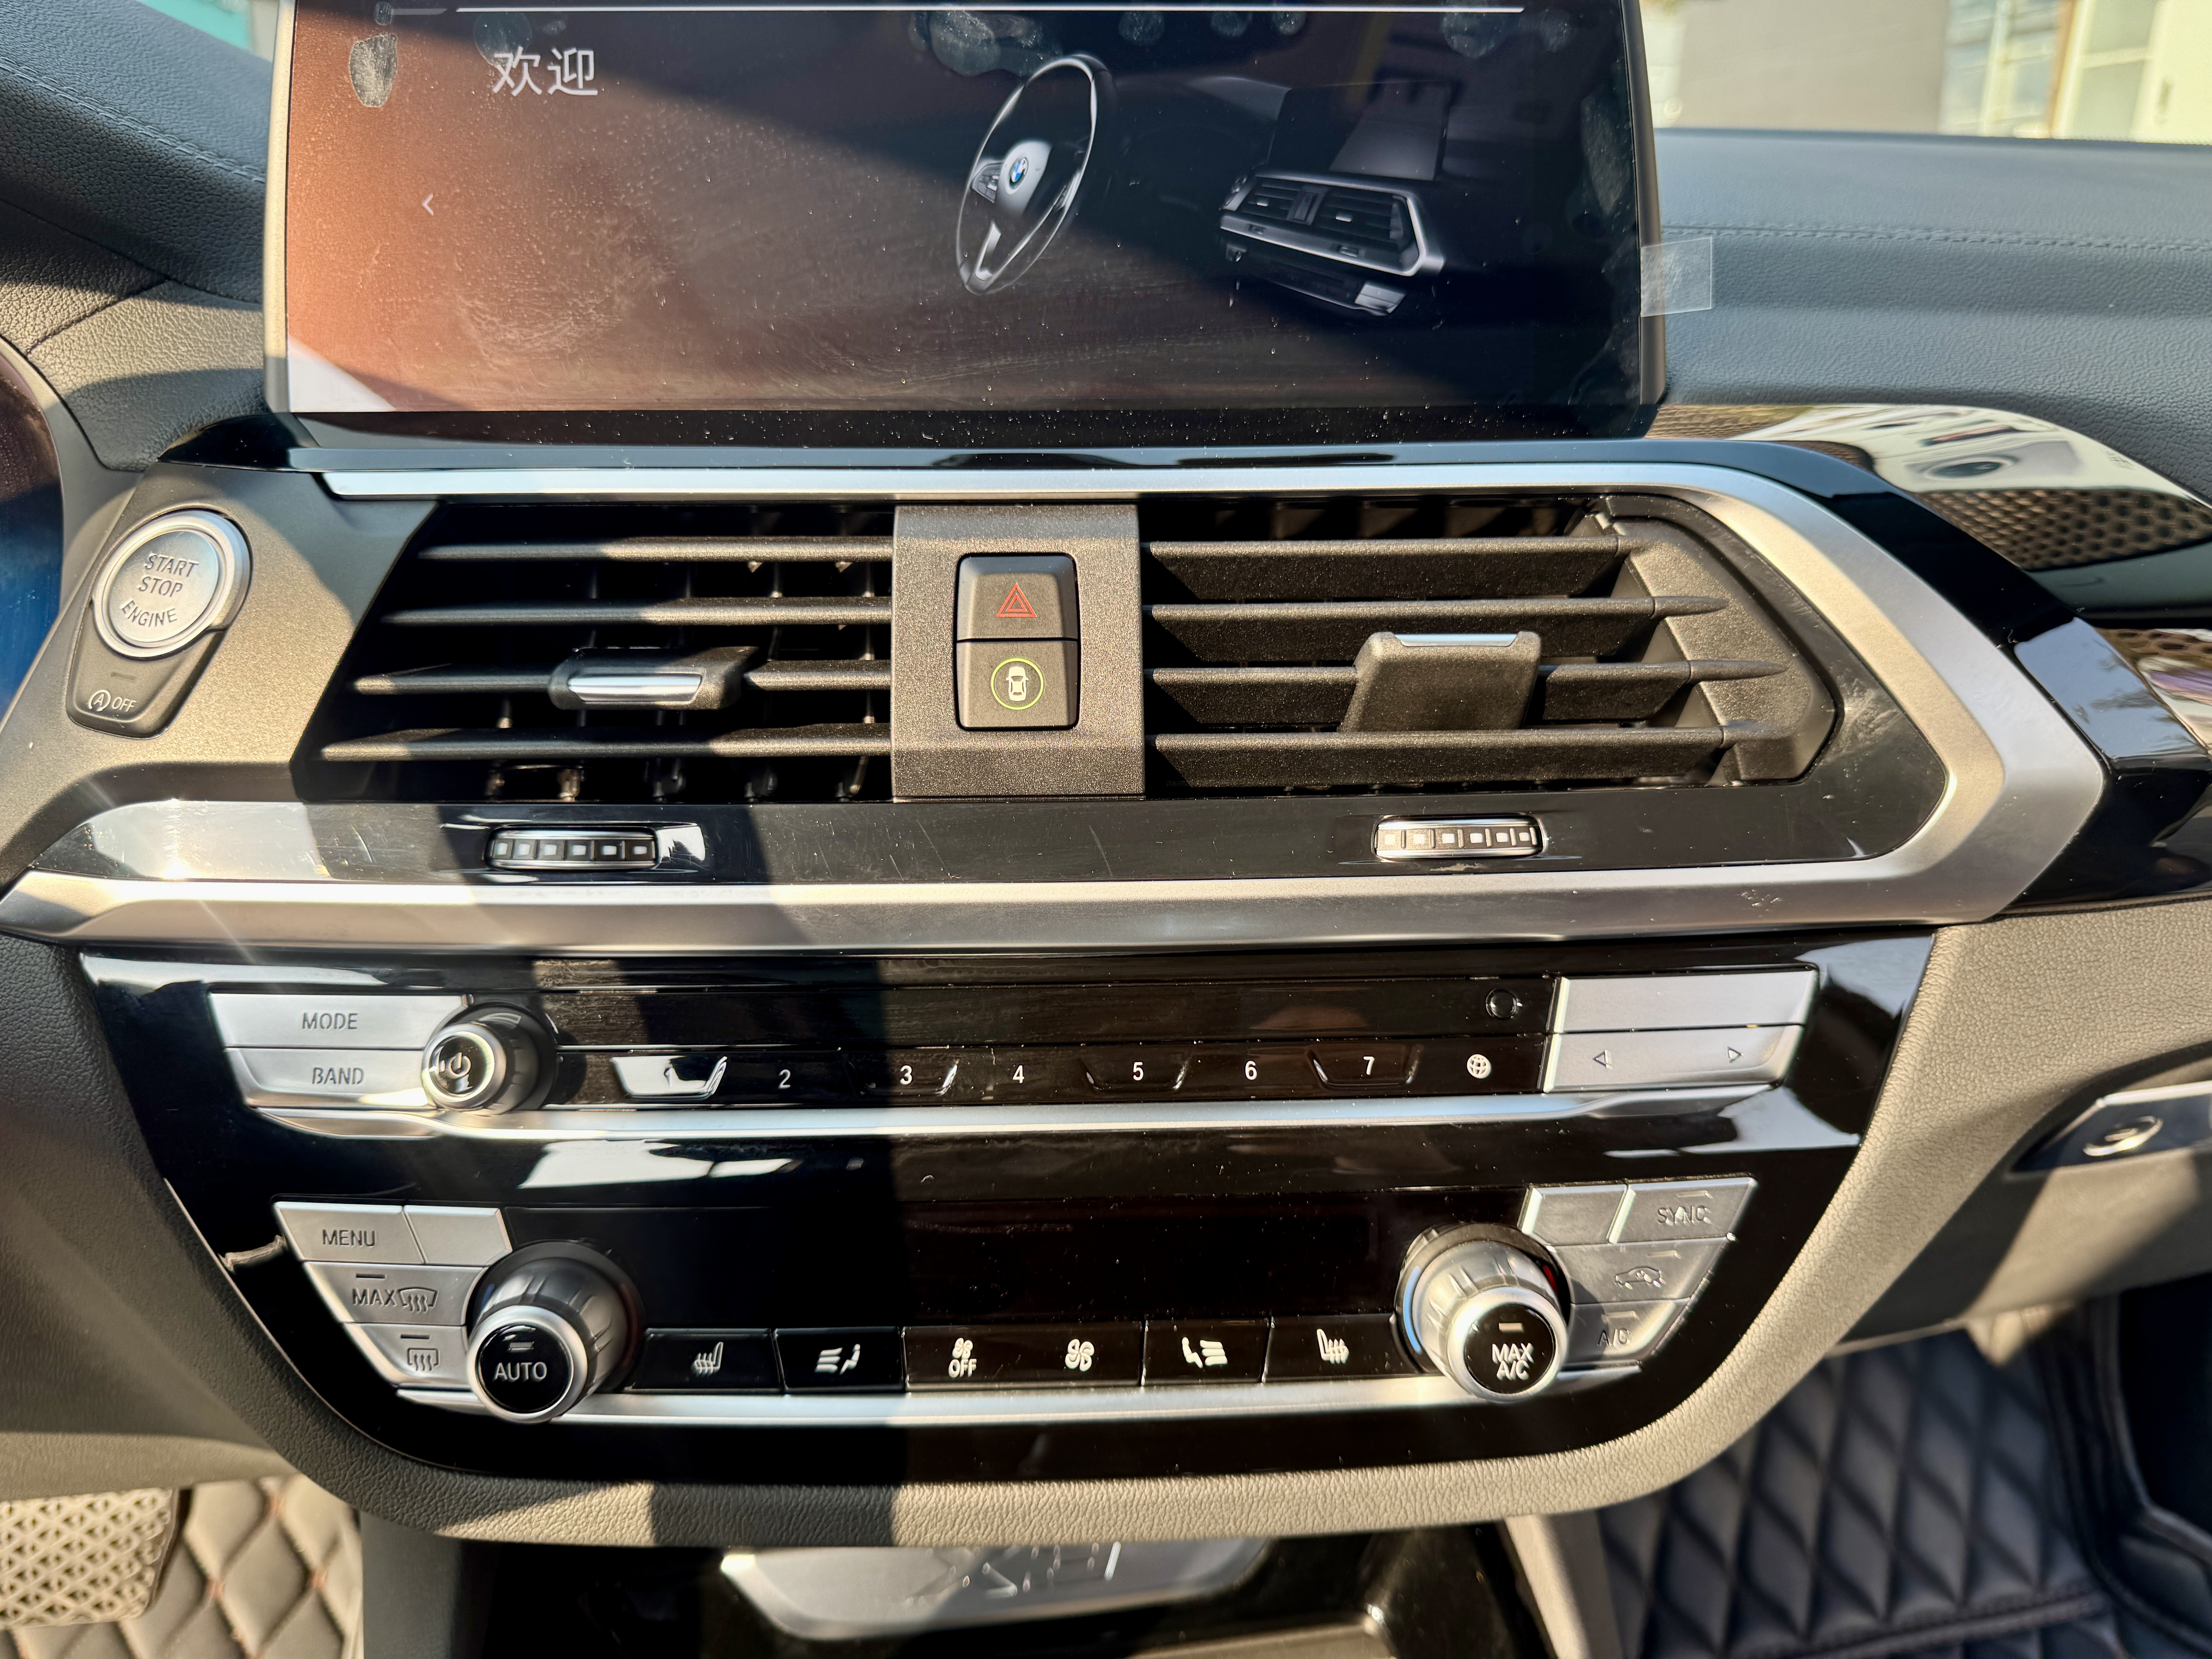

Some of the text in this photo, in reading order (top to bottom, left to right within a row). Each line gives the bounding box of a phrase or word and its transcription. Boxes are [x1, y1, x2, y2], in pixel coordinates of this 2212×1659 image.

[493, 46, 598, 97] 欢迎
[144, 553, 199, 577] START
[138, 575, 184, 598] STOP
[119, 599, 178, 627] ENGINE
[111, 696, 137, 712] OFF
[302, 1012, 359, 1030] MODE
[312, 1067, 365, 1084] BAND
[779, 1069, 791, 1089] 2
[900, 1065, 913, 1085] 3
[1012, 1065, 1025, 1084] 4
[1133, 1061, 1144, 1081] 5
[1245, 1060, 1258, 1080] 6
[1363, 1056, 1376, 1075] 7
[1657, 1205, 1711, 1227] SYNC
[323, 1229, 376, 1247] MENU
[352, 1288, 397, 1306] MAX
[1597, 1328, 1631, 1349] A/C
[1492, 1342, 1535, 1364] MAX
[493, 1361, 548, 1382] AUTO
[948, 1358, 977, 1378] OFF
[1496, 1360, 1530, 1381] A/C
